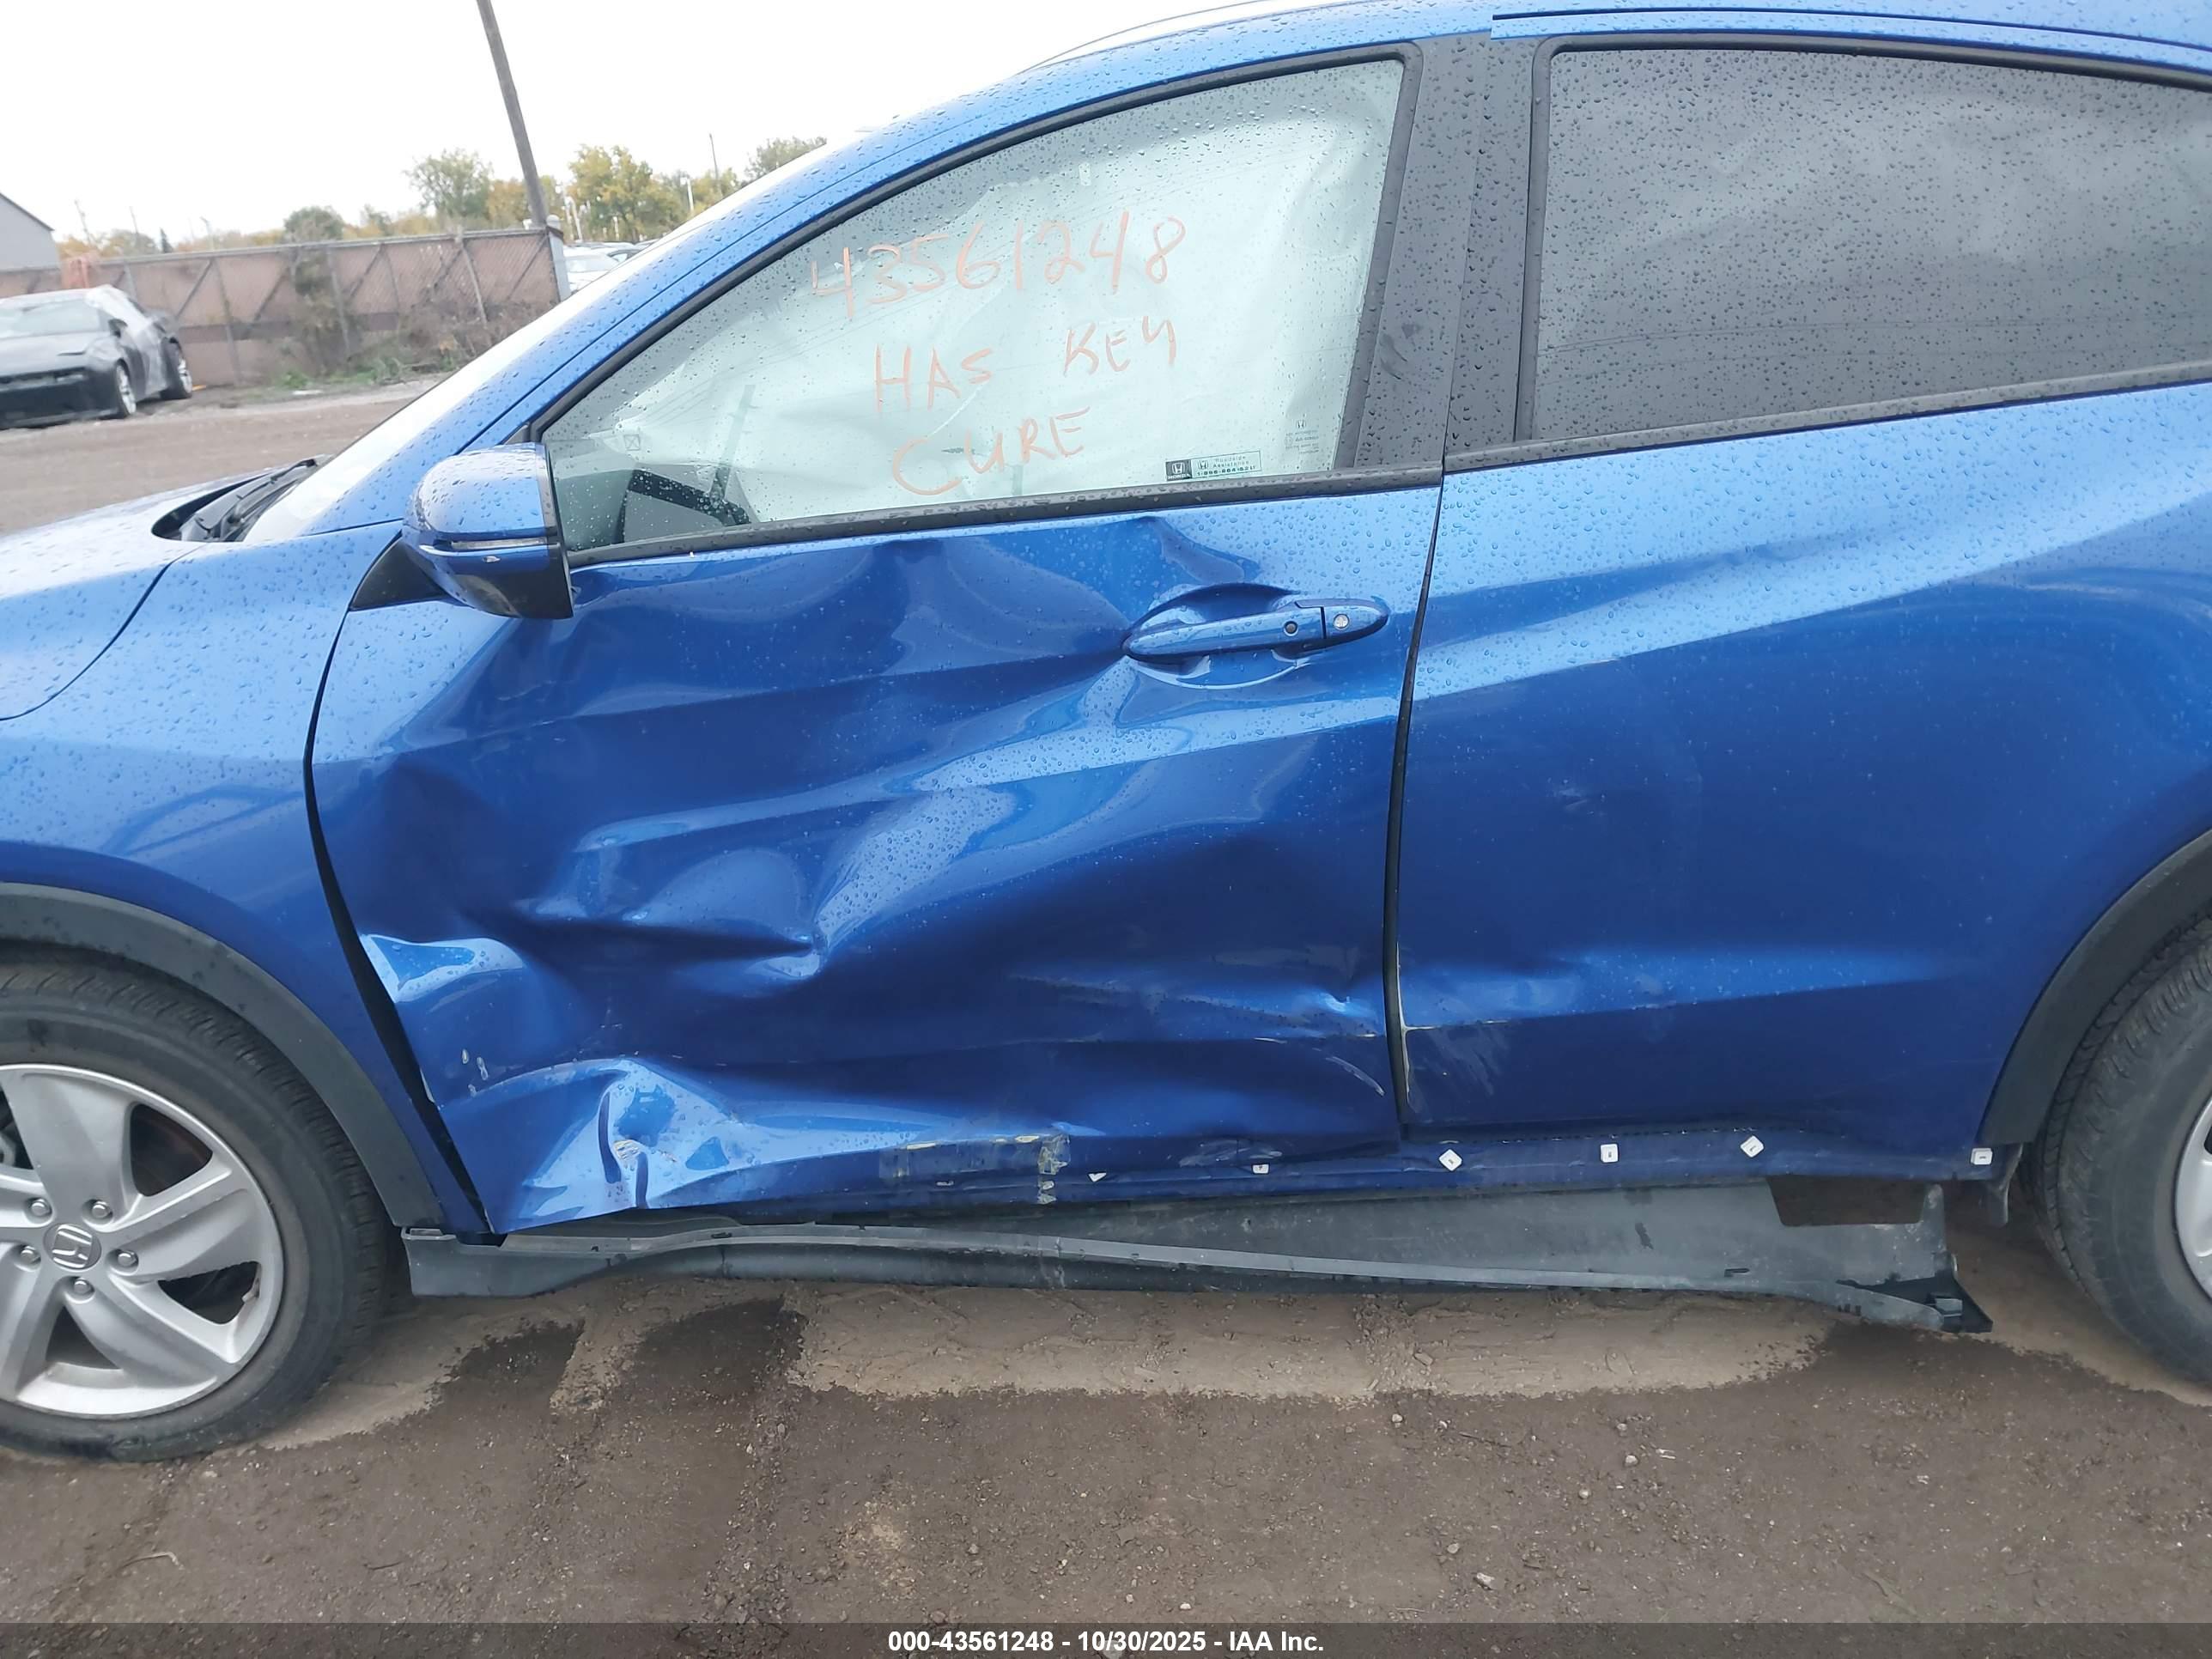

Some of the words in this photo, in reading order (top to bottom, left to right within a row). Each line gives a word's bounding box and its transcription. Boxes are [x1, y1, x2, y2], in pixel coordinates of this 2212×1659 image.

[810, 210, 1187, 318] 43561248
[874, 344, 993, 412] HAS
[1063, 315, 1177, 377] KEY
[892, 406, 1091, 495] CURE
